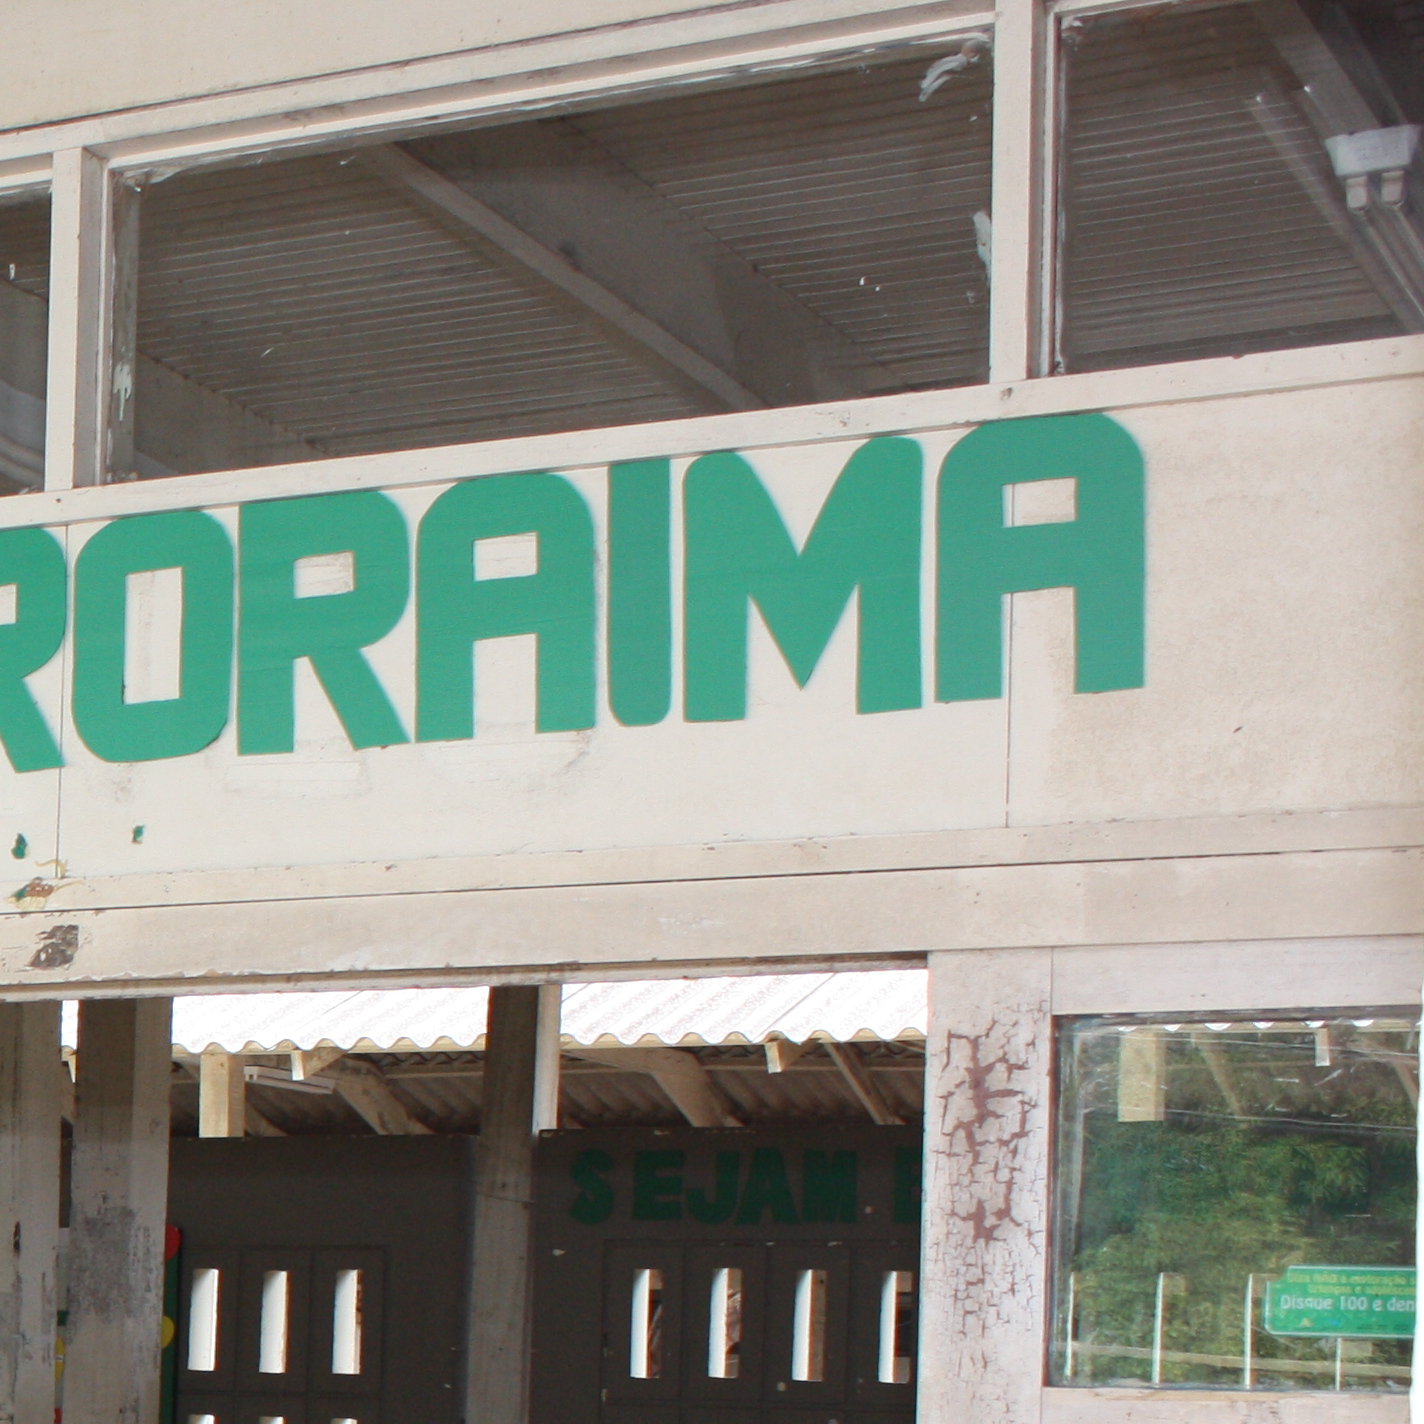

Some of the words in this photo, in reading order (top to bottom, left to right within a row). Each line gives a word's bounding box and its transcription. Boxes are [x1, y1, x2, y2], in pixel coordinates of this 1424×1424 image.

[568, 1147, 858, 1226] SEJAM
[1340, 1296, 1368, 1311] 100
[1372, 1300, 1383, 1311] e
